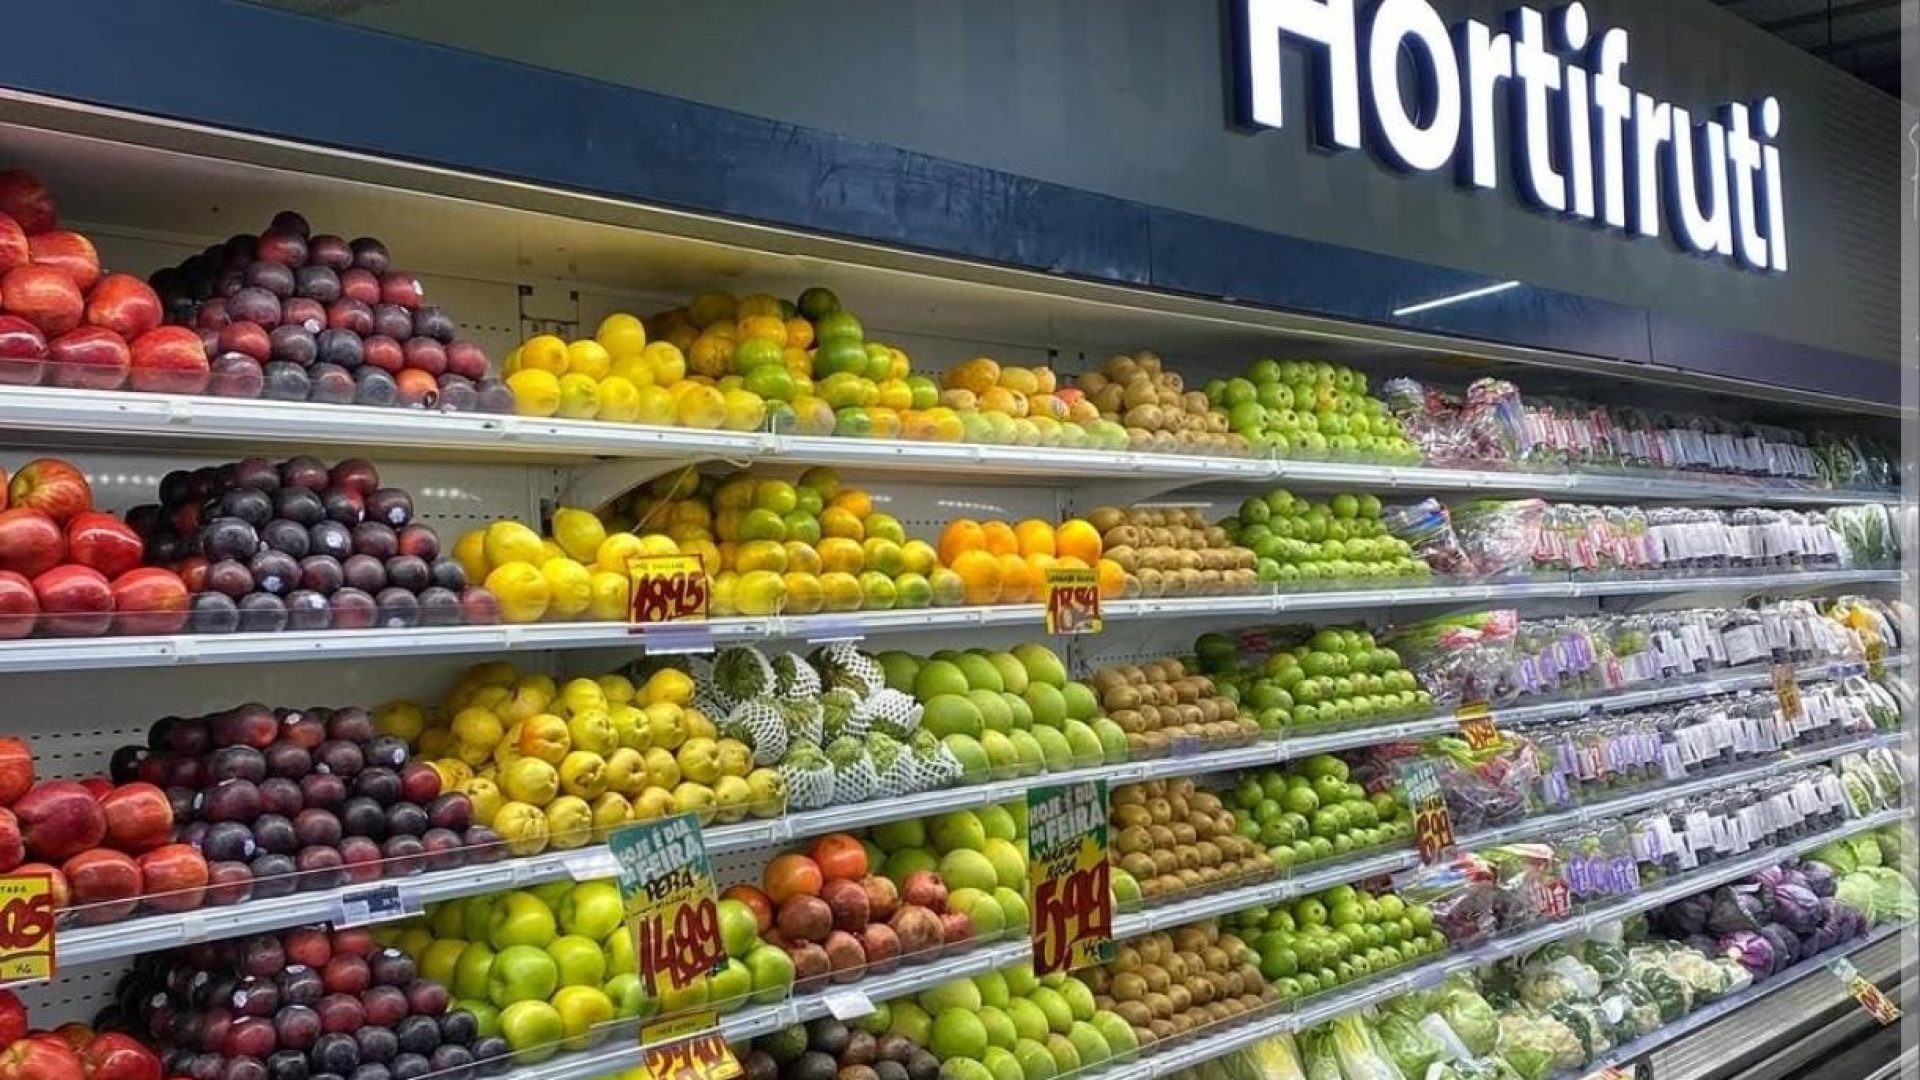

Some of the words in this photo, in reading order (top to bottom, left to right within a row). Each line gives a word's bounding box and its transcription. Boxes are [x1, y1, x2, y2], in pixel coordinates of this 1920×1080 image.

[1240, 0, 1788, 272] Hortifruti
[1030, 797, 1061, 826] HOJE
[1046, 798, 1106, 849] FEIRA
[635, 834, 702, 887] FEIRA
